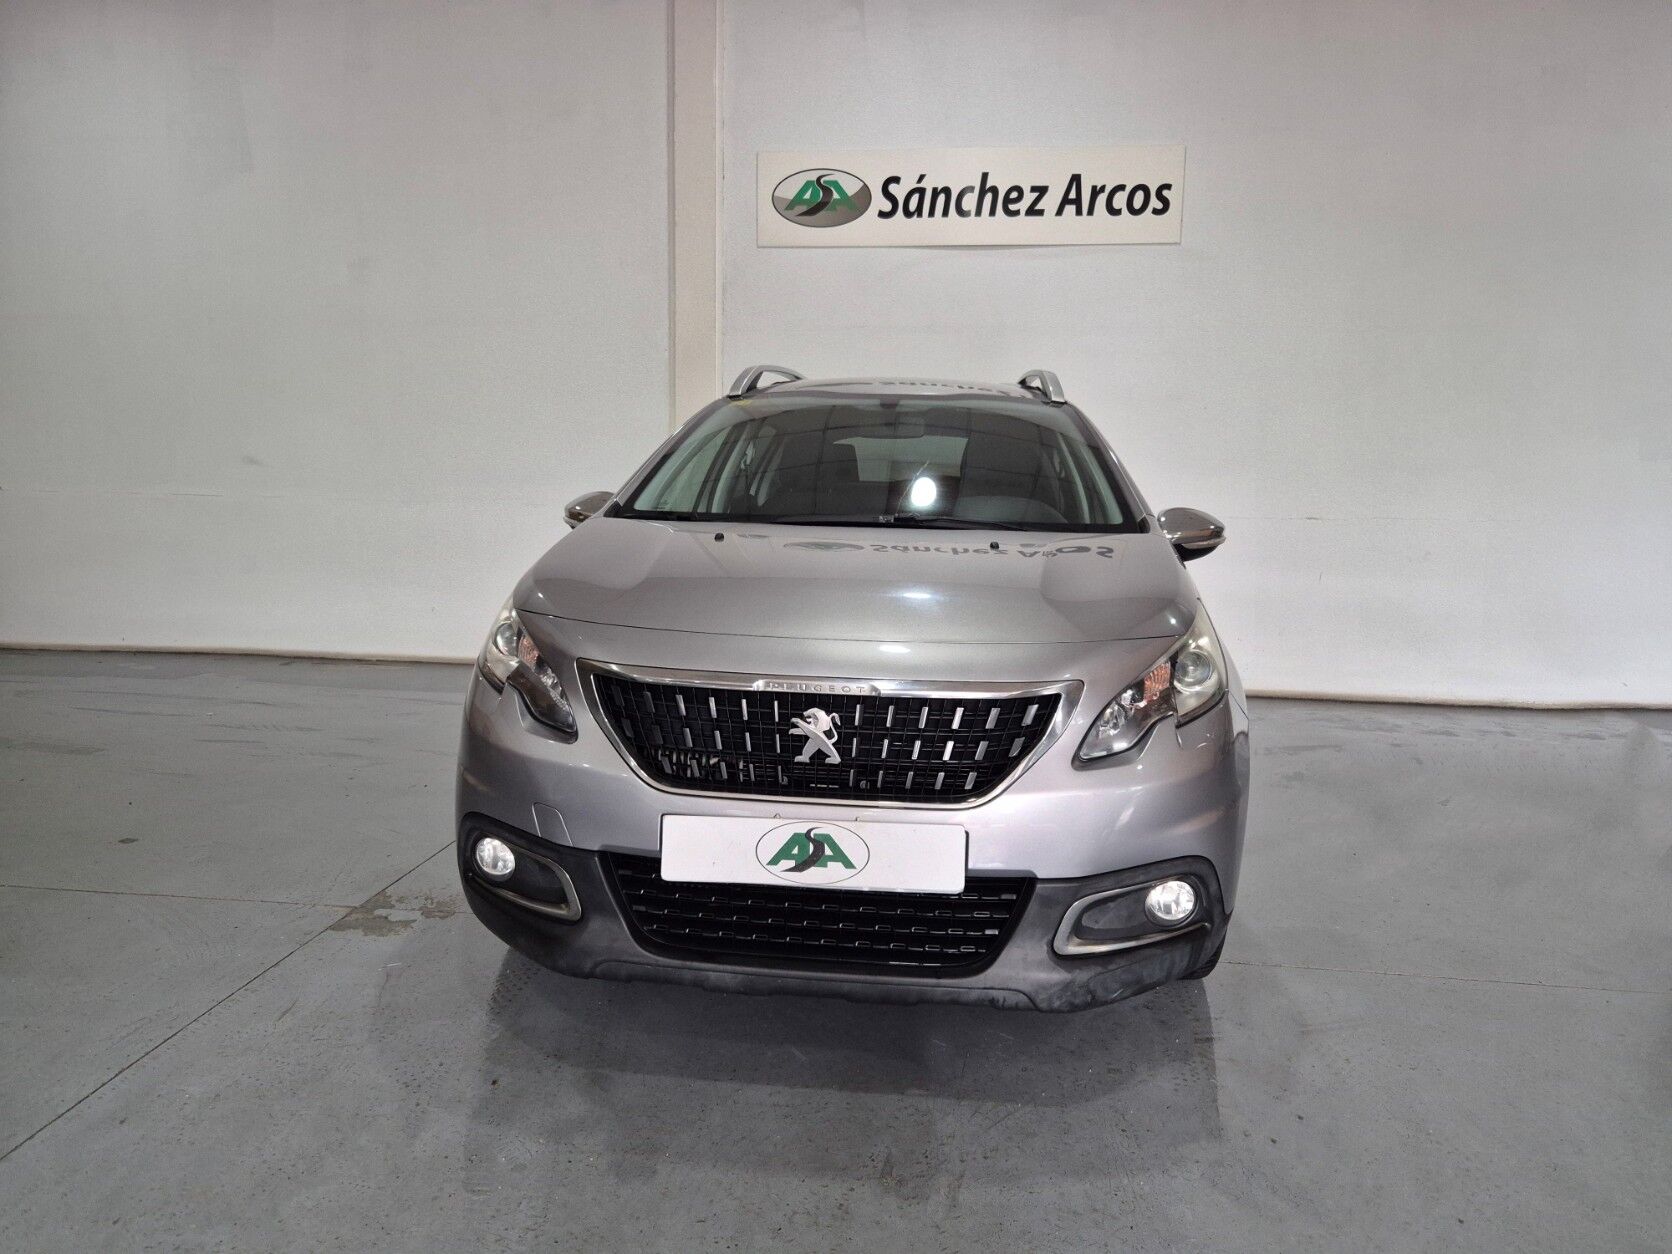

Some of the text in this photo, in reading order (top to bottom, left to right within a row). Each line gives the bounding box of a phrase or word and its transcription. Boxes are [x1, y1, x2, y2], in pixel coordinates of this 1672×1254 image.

[877, 171, 1050, 219] Sánchez
[1055, 173, 1173, 217] Arcos
[769, 682, 866, 694] PEUGEOT
